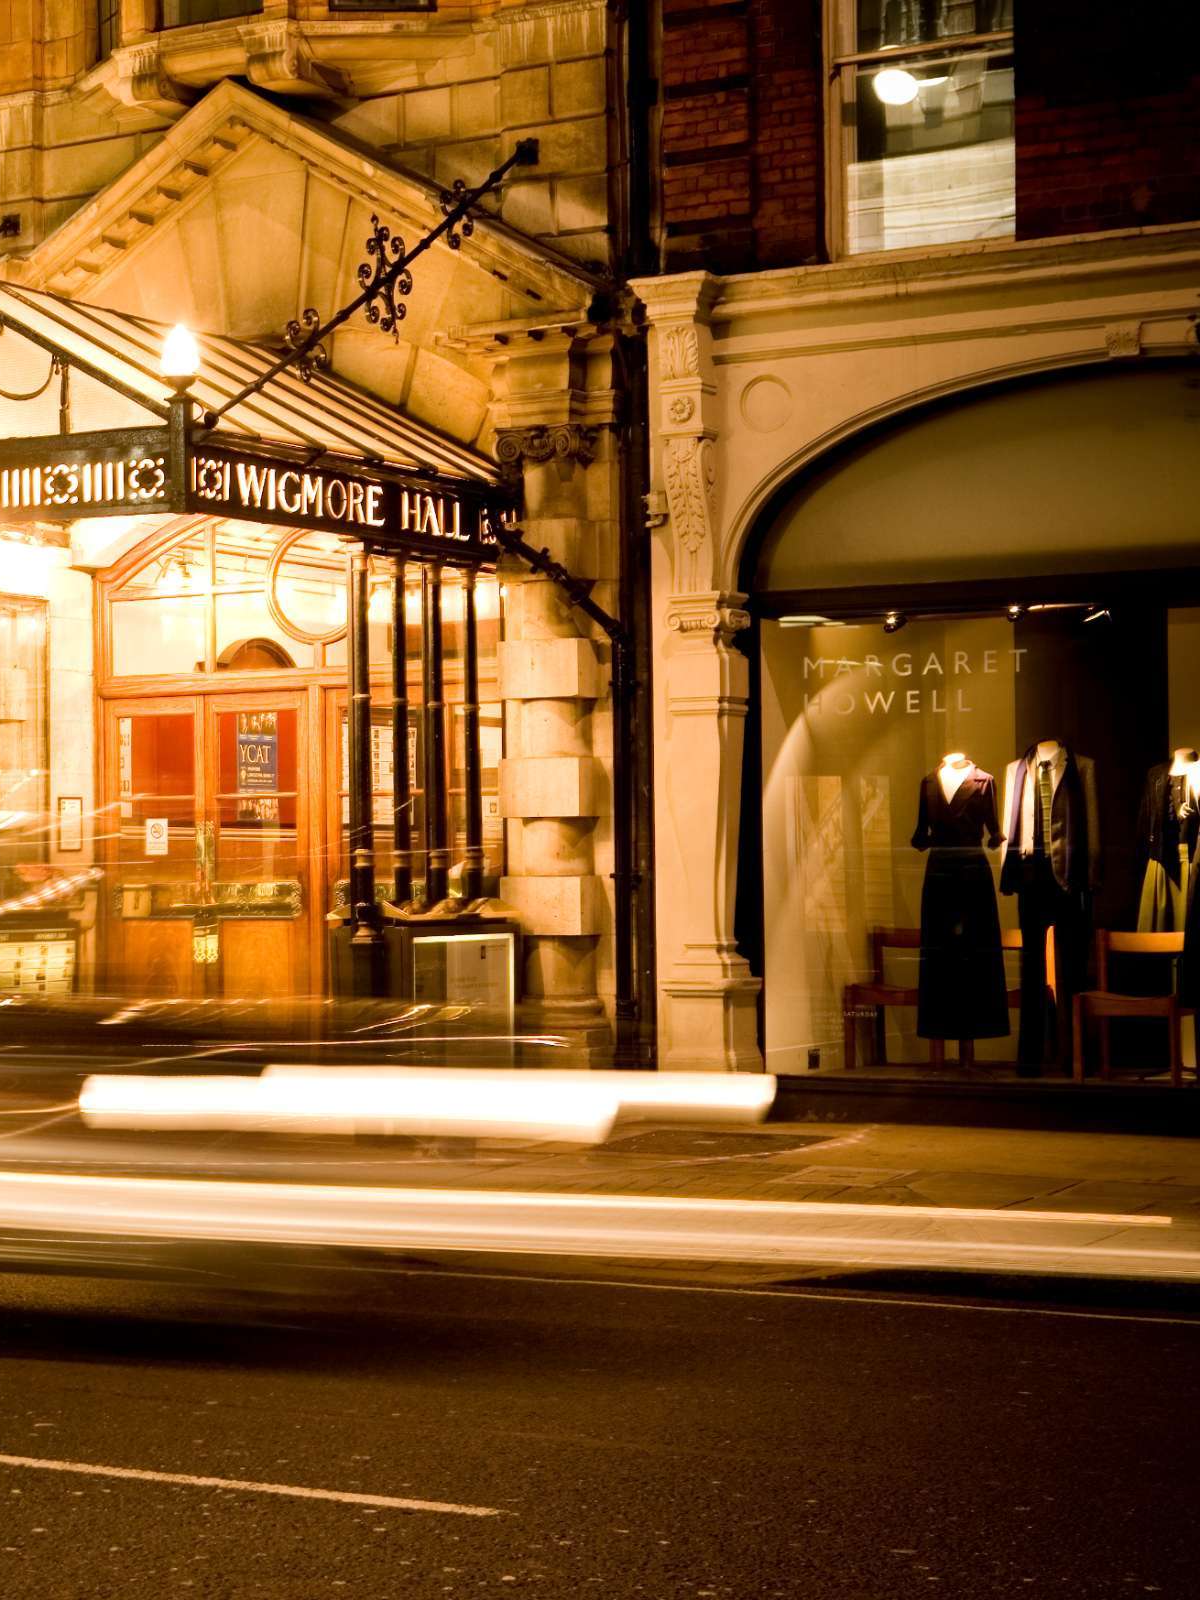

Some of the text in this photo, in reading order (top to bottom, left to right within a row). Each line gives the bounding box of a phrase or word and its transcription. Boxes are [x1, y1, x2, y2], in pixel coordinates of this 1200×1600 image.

[237, 463, 470, 541] WIGMORE HALL
[803, 649, 1028, 679] MARGARET
[803, 689, 973, 716] HOWELL
[240, 744, 272, 764] YCAT
